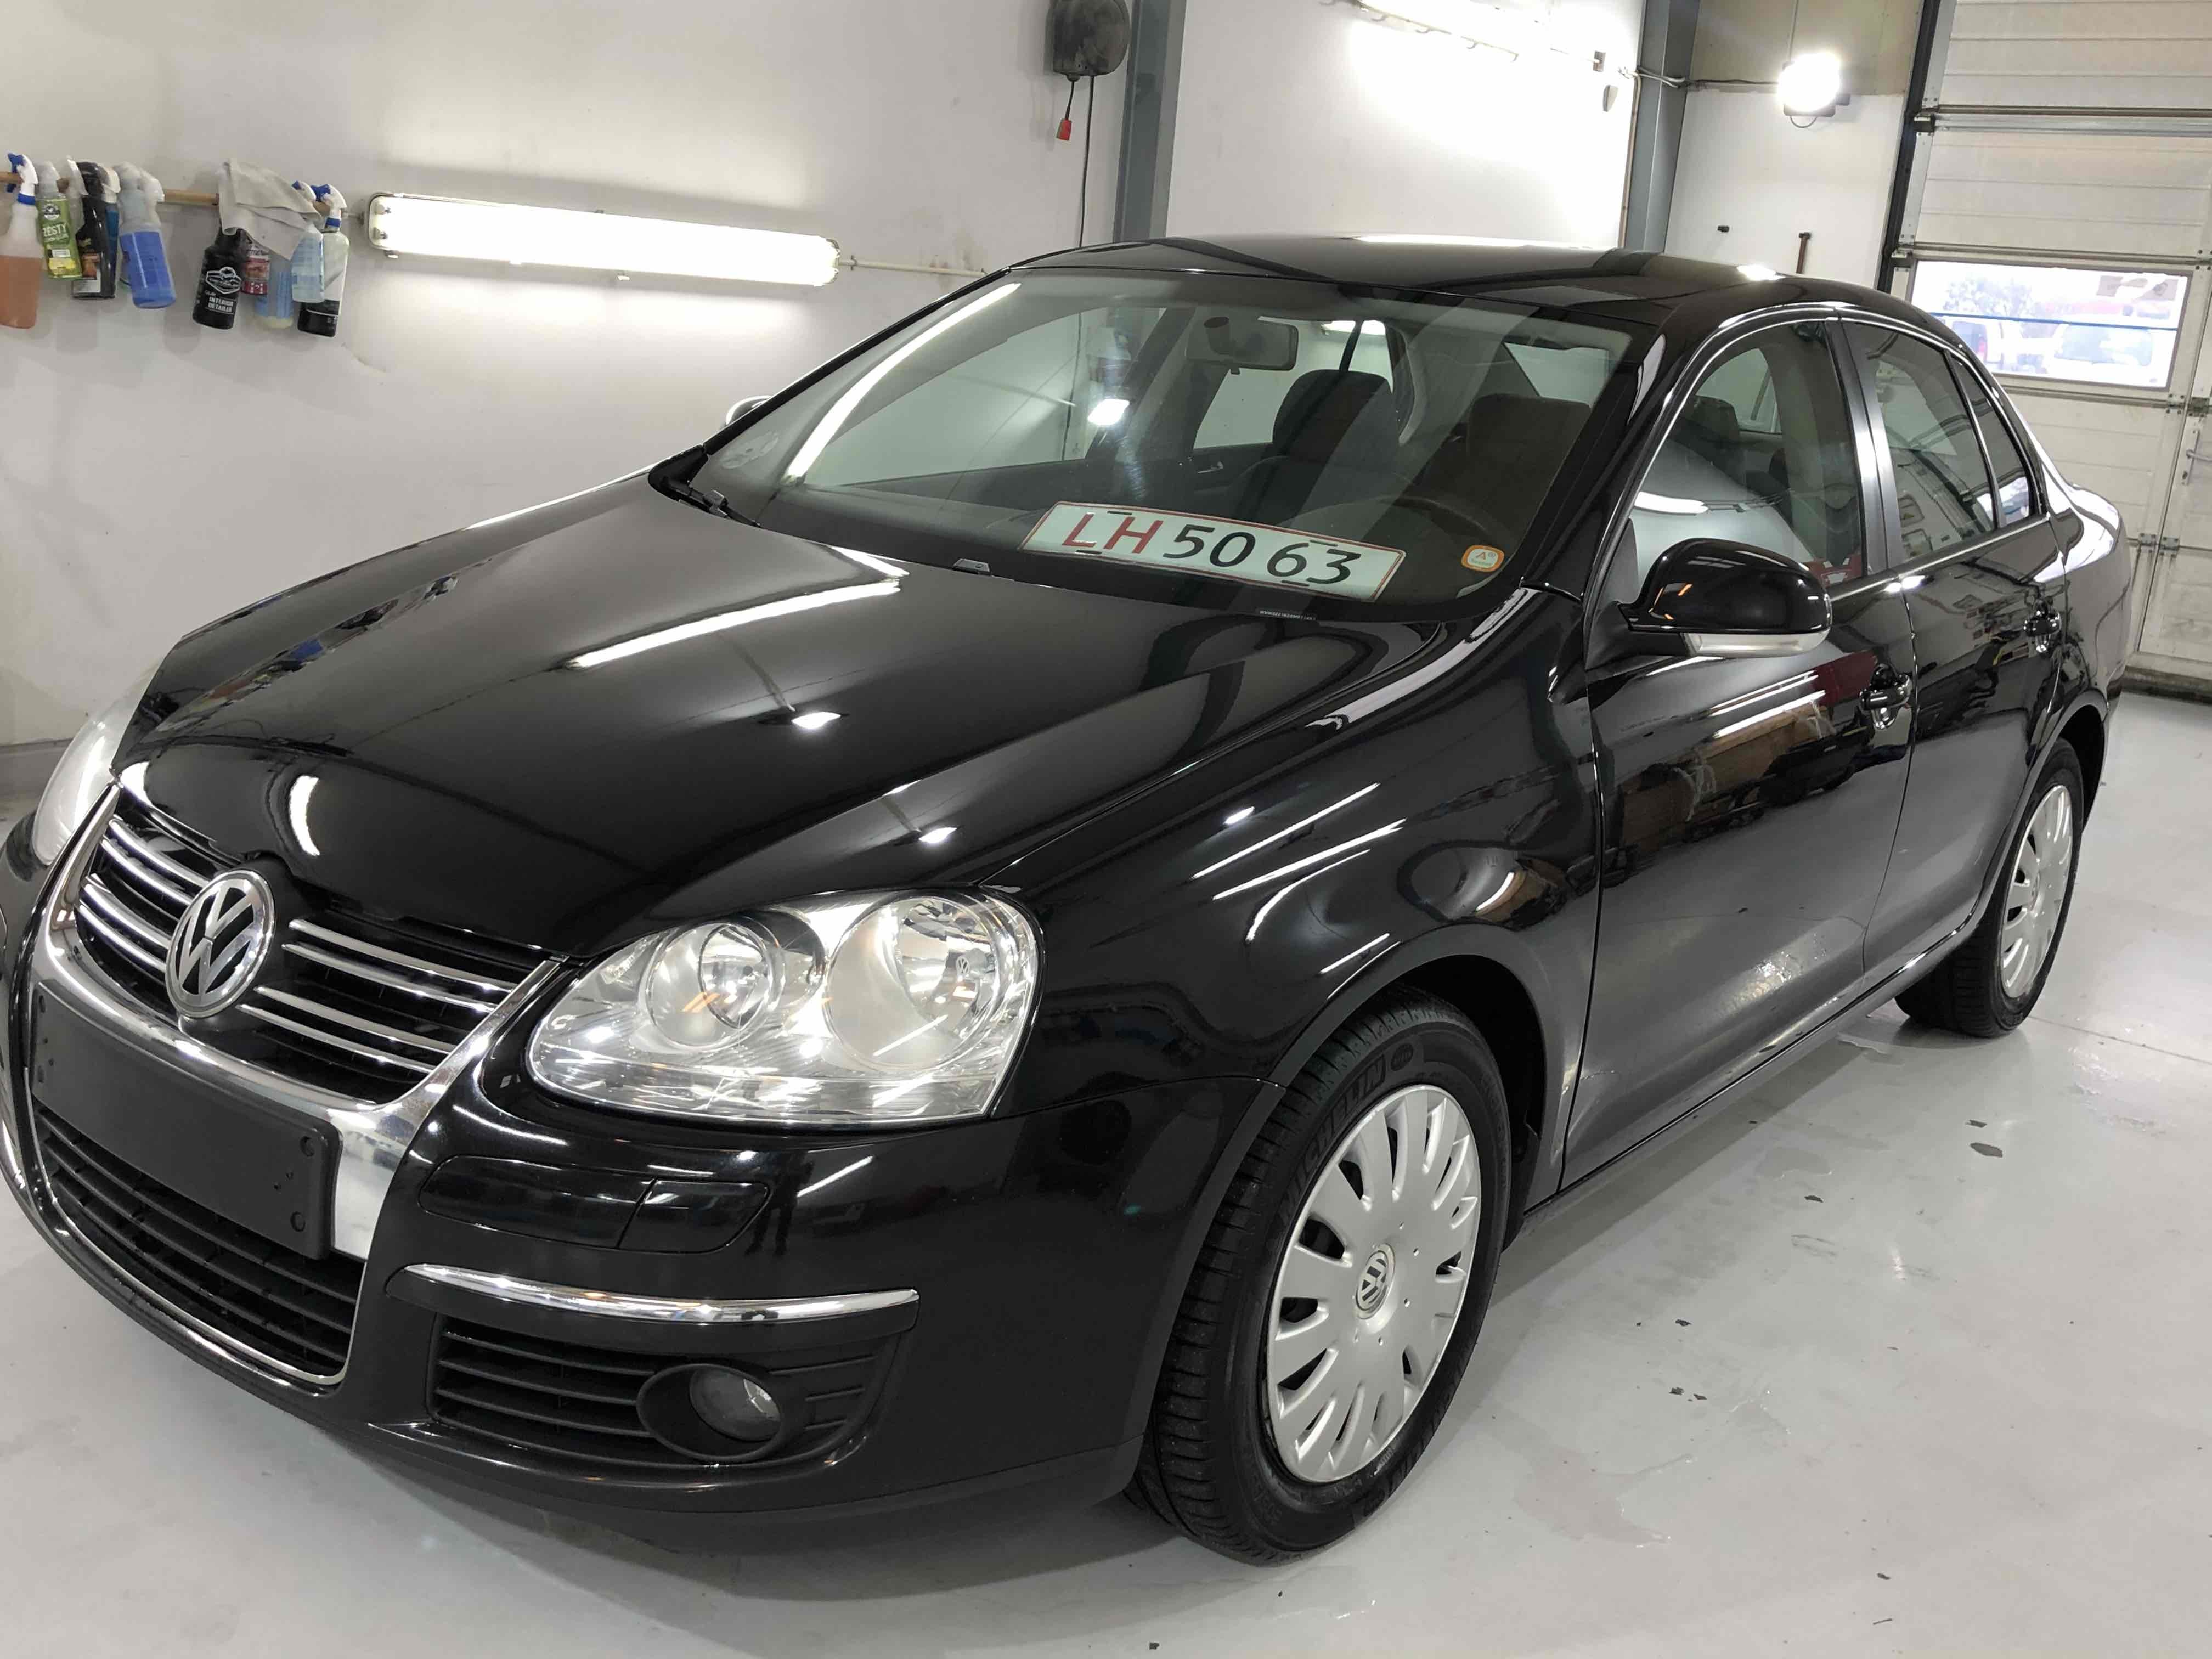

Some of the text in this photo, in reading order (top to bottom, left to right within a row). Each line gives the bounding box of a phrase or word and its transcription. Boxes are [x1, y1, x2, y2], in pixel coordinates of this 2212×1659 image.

[42, 223, 66, 237] ZESTY
[1062, 508, 1362, 584] LH 50 63
[1275, 1057, 1383, 1225] MICHELIN
